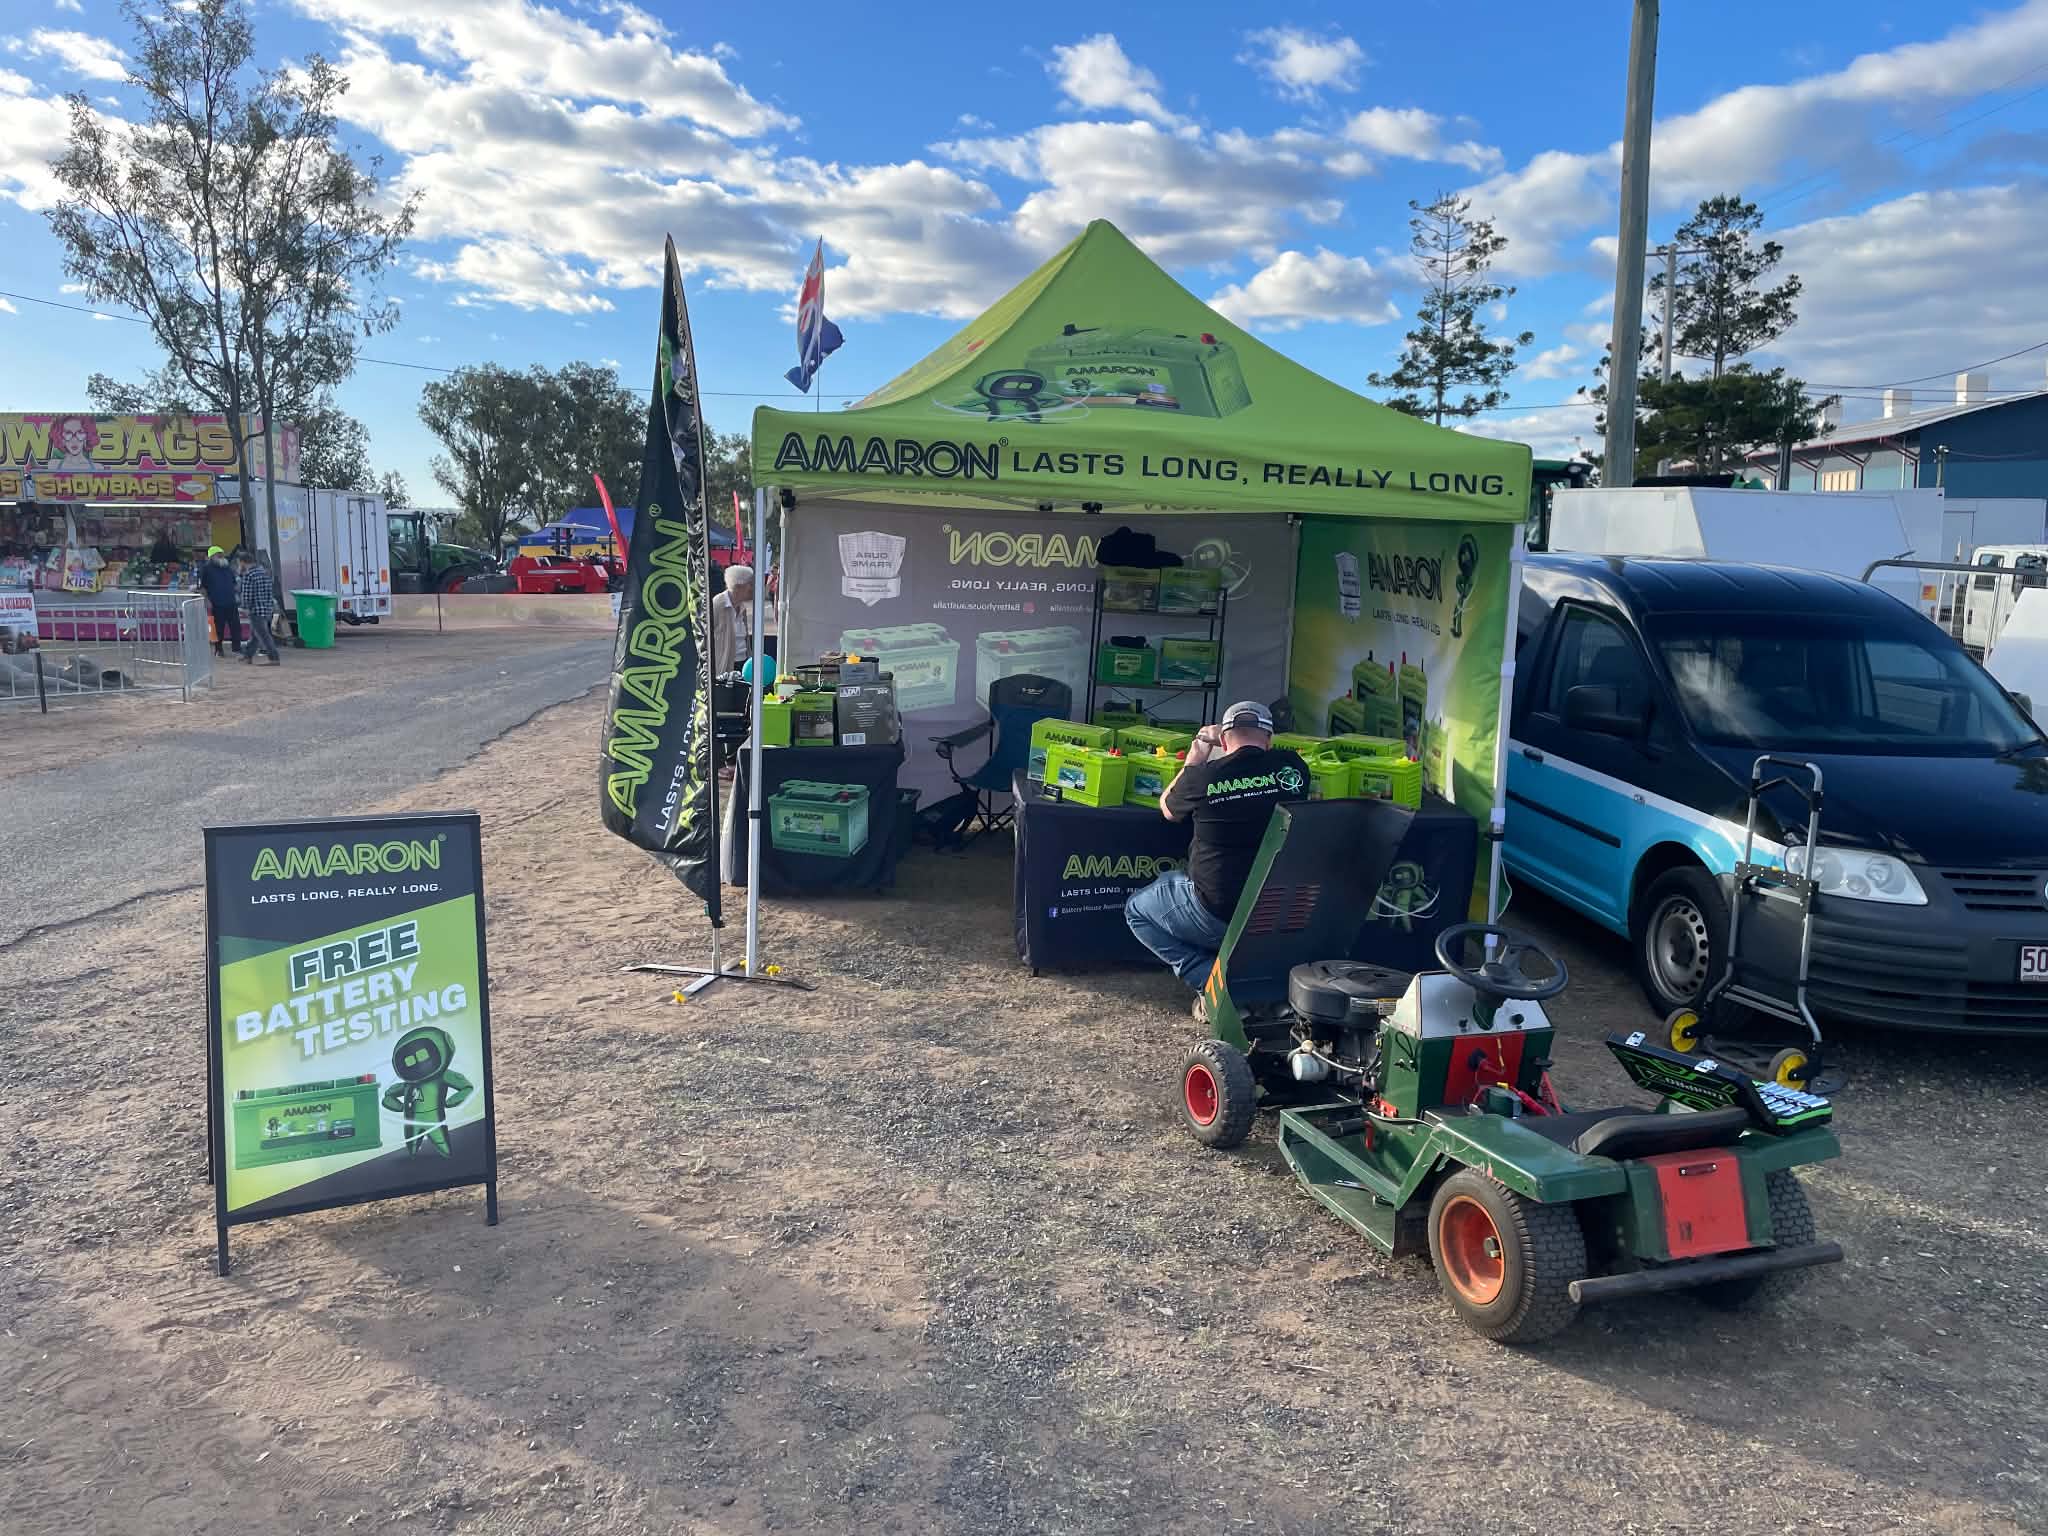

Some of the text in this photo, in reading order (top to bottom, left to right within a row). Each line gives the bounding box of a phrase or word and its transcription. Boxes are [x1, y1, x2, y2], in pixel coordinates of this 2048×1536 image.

[91, 423, 236, 465] BAGS
[38, 476, 177, 496] SHOWBAGS
[1013, 451, 1124, 475] LASTS
[1142, 455, 1248, 484] LONG,
[1263, 463, 1393, 489] REALLY
[1410, 471, 1513, 496] LONG.
[607, 519, 689, 818] AMARON
[655, 764, 685, 831] LASTS
[1207, 774, 1276, 796] AMARON
[252, 839, 440, 881] AMARON
[1063, 854, 1185, 880] AMARO
[251, 883, 443, 904] LASTS LONG, REALLY LONG.
[1061, 888, 1091, 898] LASTS
[289, 920, 421, 993] FREE
[236, 962, 418, 1043] BATTERY
[296, 984, 468, 1057] TESTING
[283, 1103, 332, 1118] AMARON
